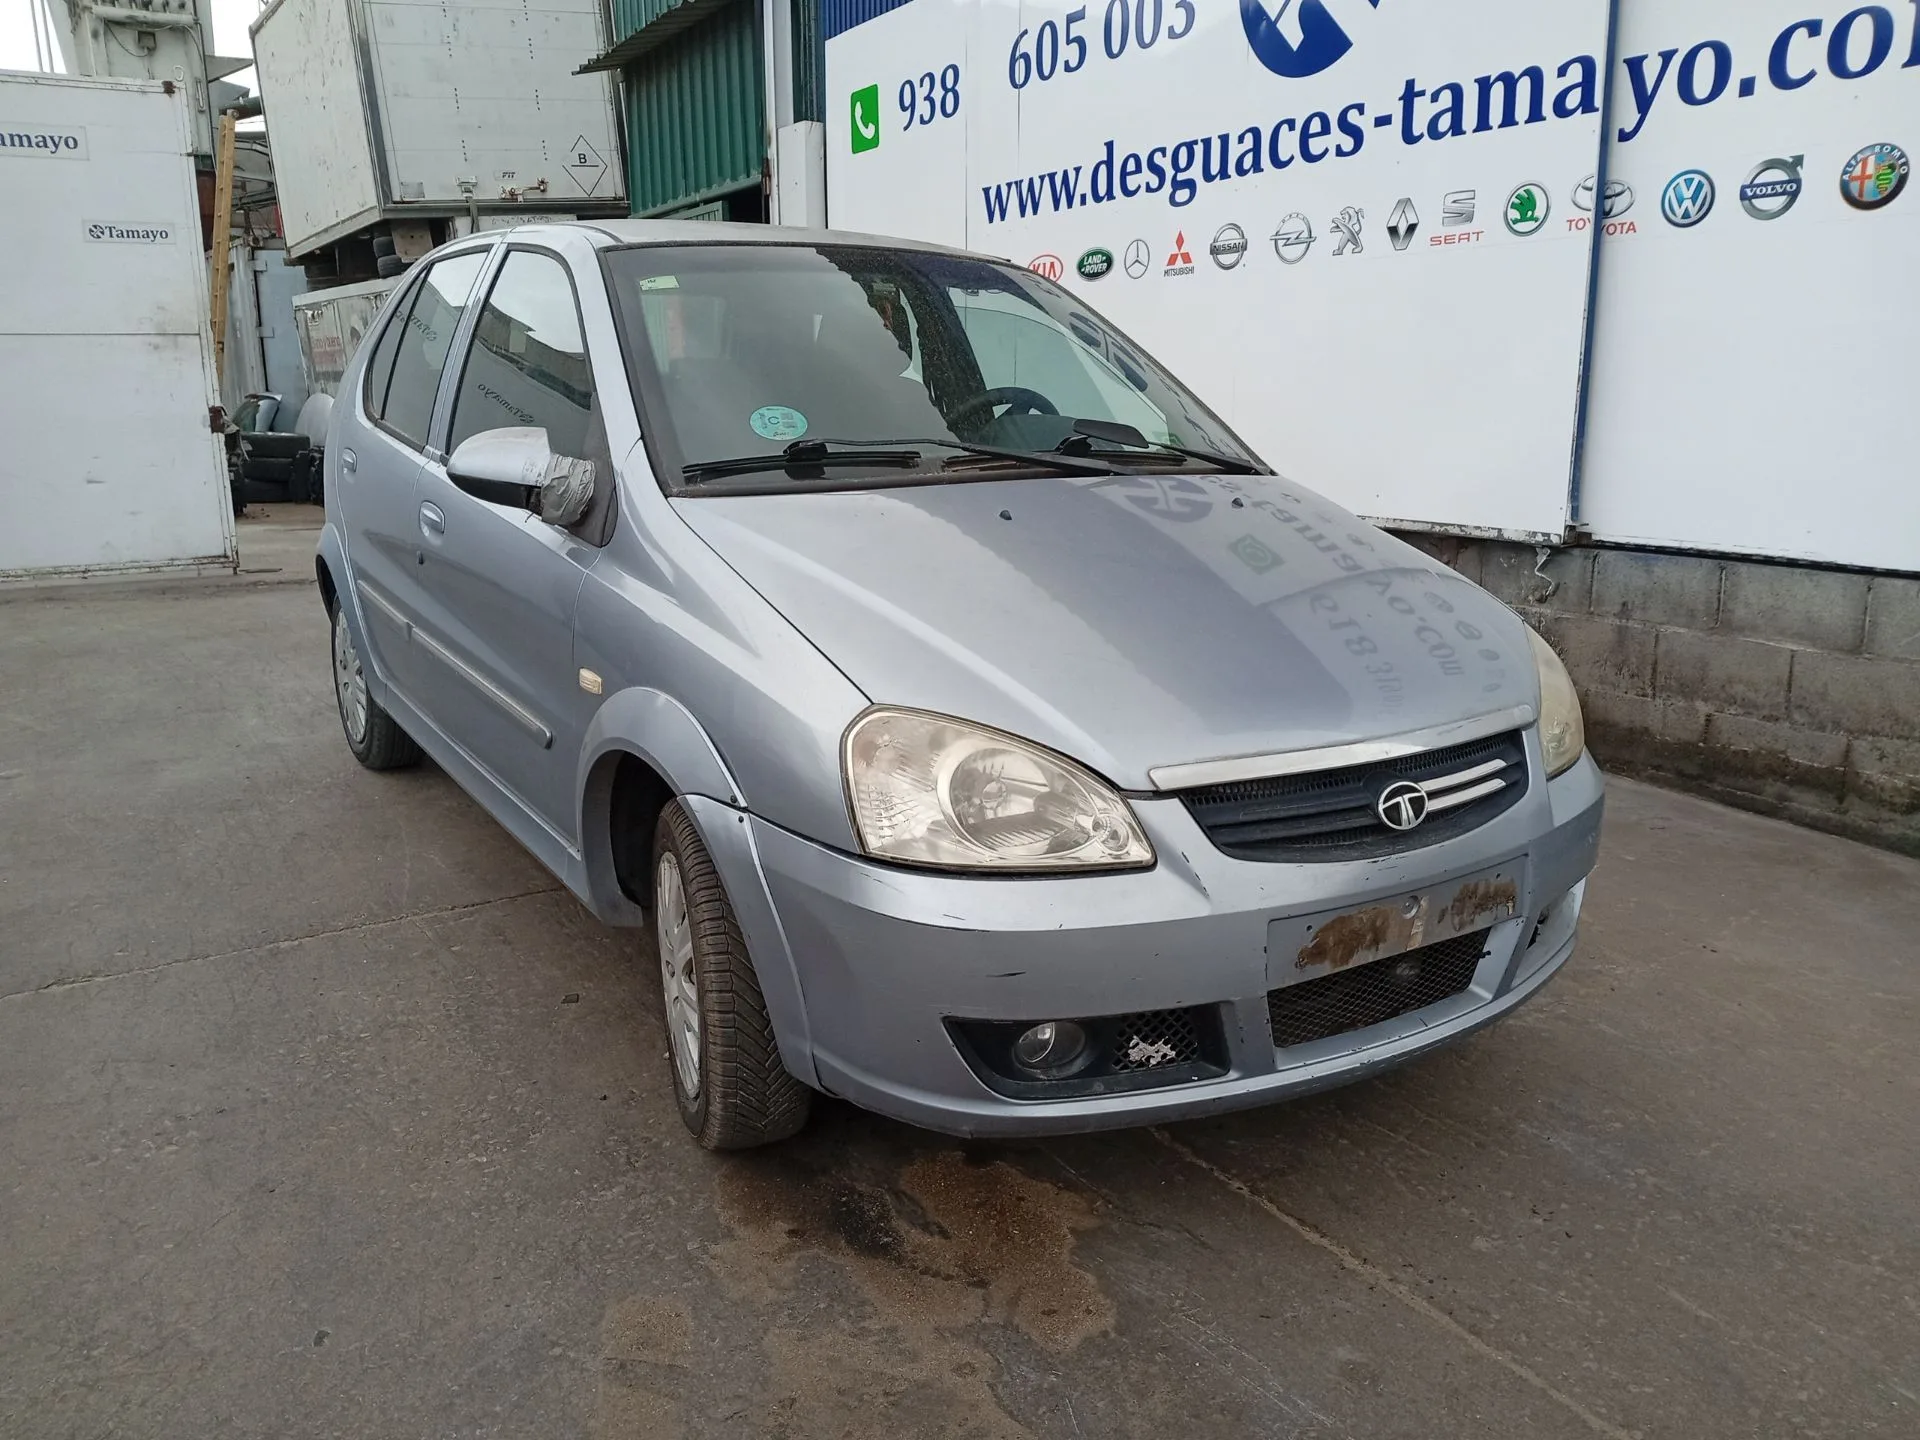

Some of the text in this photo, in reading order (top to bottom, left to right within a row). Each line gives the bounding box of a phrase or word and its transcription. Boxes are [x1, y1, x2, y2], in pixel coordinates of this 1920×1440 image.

[899, 0, 1196, 132] 938 605 003
[982, 0, 1920, 223] www.desguaces-tamayo.co
[577, 153, 588, 164] B
[1842, 144, 1908, 181] ALFA ROMEO
[1743, 182, 1798, 197] VOLVO
[105, 226, 169, 242] Tamayo
[1429, 230, 1485, 247] SEAT
[1213, 240, 1245, 252] NISSAN
[1084, 254, 1103, 265] LAND
[1084, 262, 1108, 274] ROVER
[1163, 265, 1195, 278] MITSUBISHI
